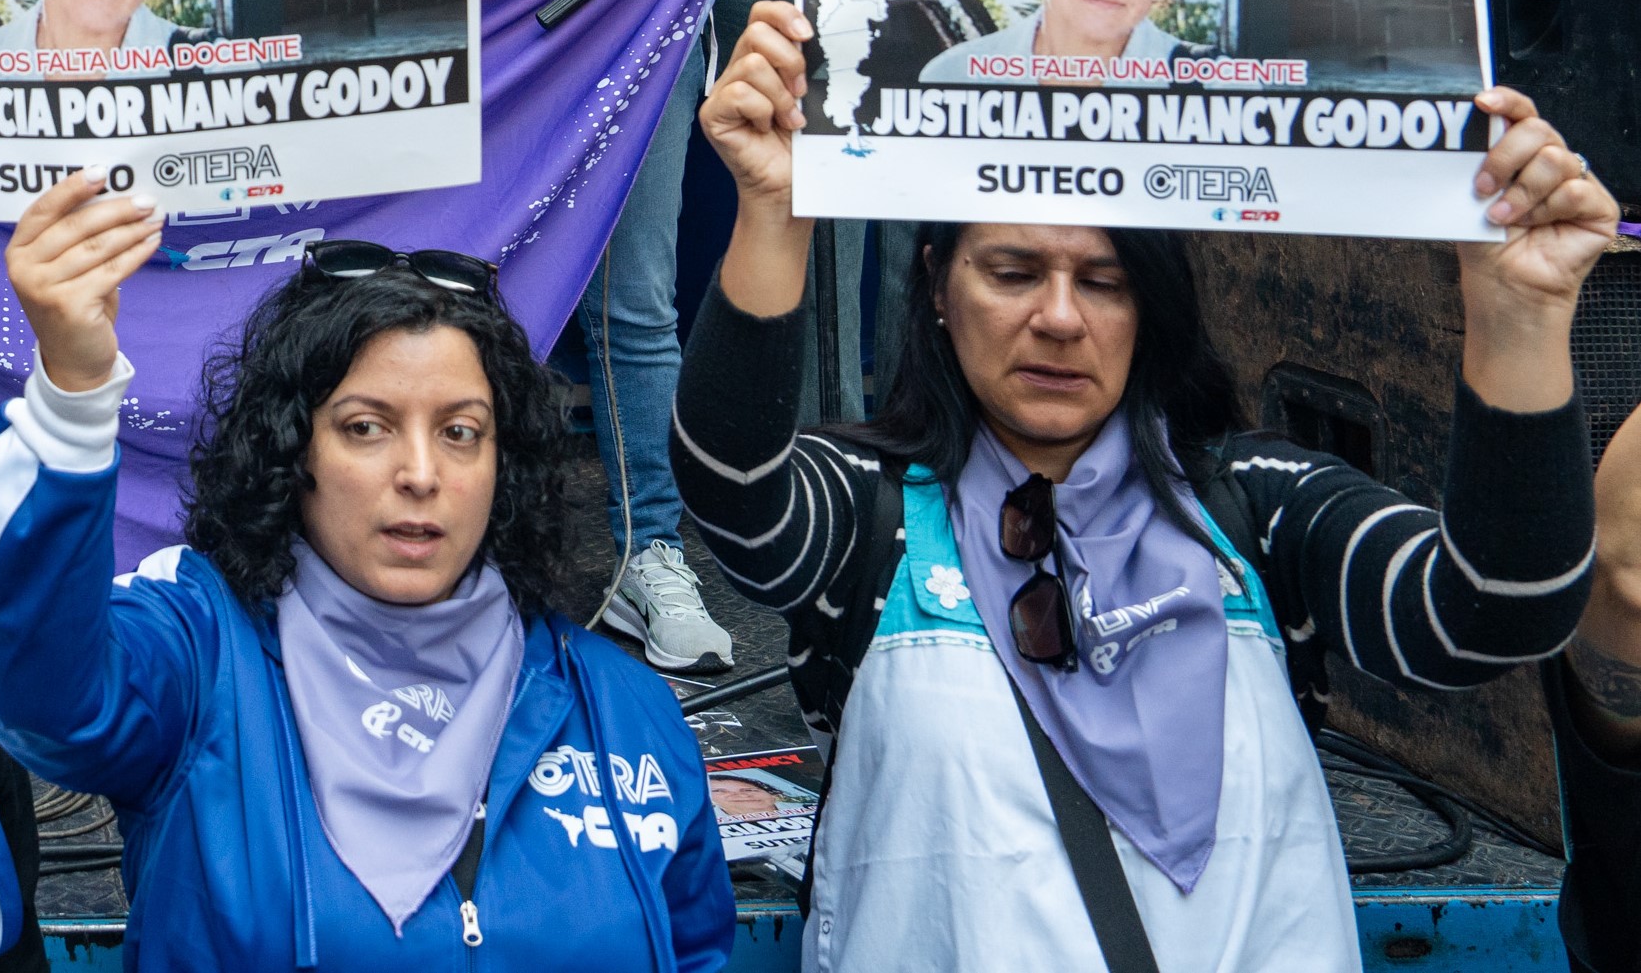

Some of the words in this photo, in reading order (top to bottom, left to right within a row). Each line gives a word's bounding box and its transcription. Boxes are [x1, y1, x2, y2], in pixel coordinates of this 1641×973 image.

[37, 47, 107, 72] FALTA
[112, 45, 170, 70] UNA
[175, 35, 300, 64] DOCENTE
[969, 55, 1025, 78] NOS
[1031, 56, 1104, 80] FALTA
[1108, 57, 1168, 81] UNA
[1176, 59, 1307, 83] DOCENTE
[61, 85, 146, 140] POR
[151, 74, 299, 134] NANCY
[300, 57, 454, 118] GODOY
[871, 87, 1054, 137] JUSTICIA
[1059, 93, 1142, 141] POR
[1147, 95, 1303, 146] NANCY
[1307, 98, 1472, 151] GODOY
[153, 145, 281, 186] CTERA
[977, 164, 1125, 196] SUTECO
[1144, 164, 1277, 202] CTERA
[182, 228, 325, 271] CTA
